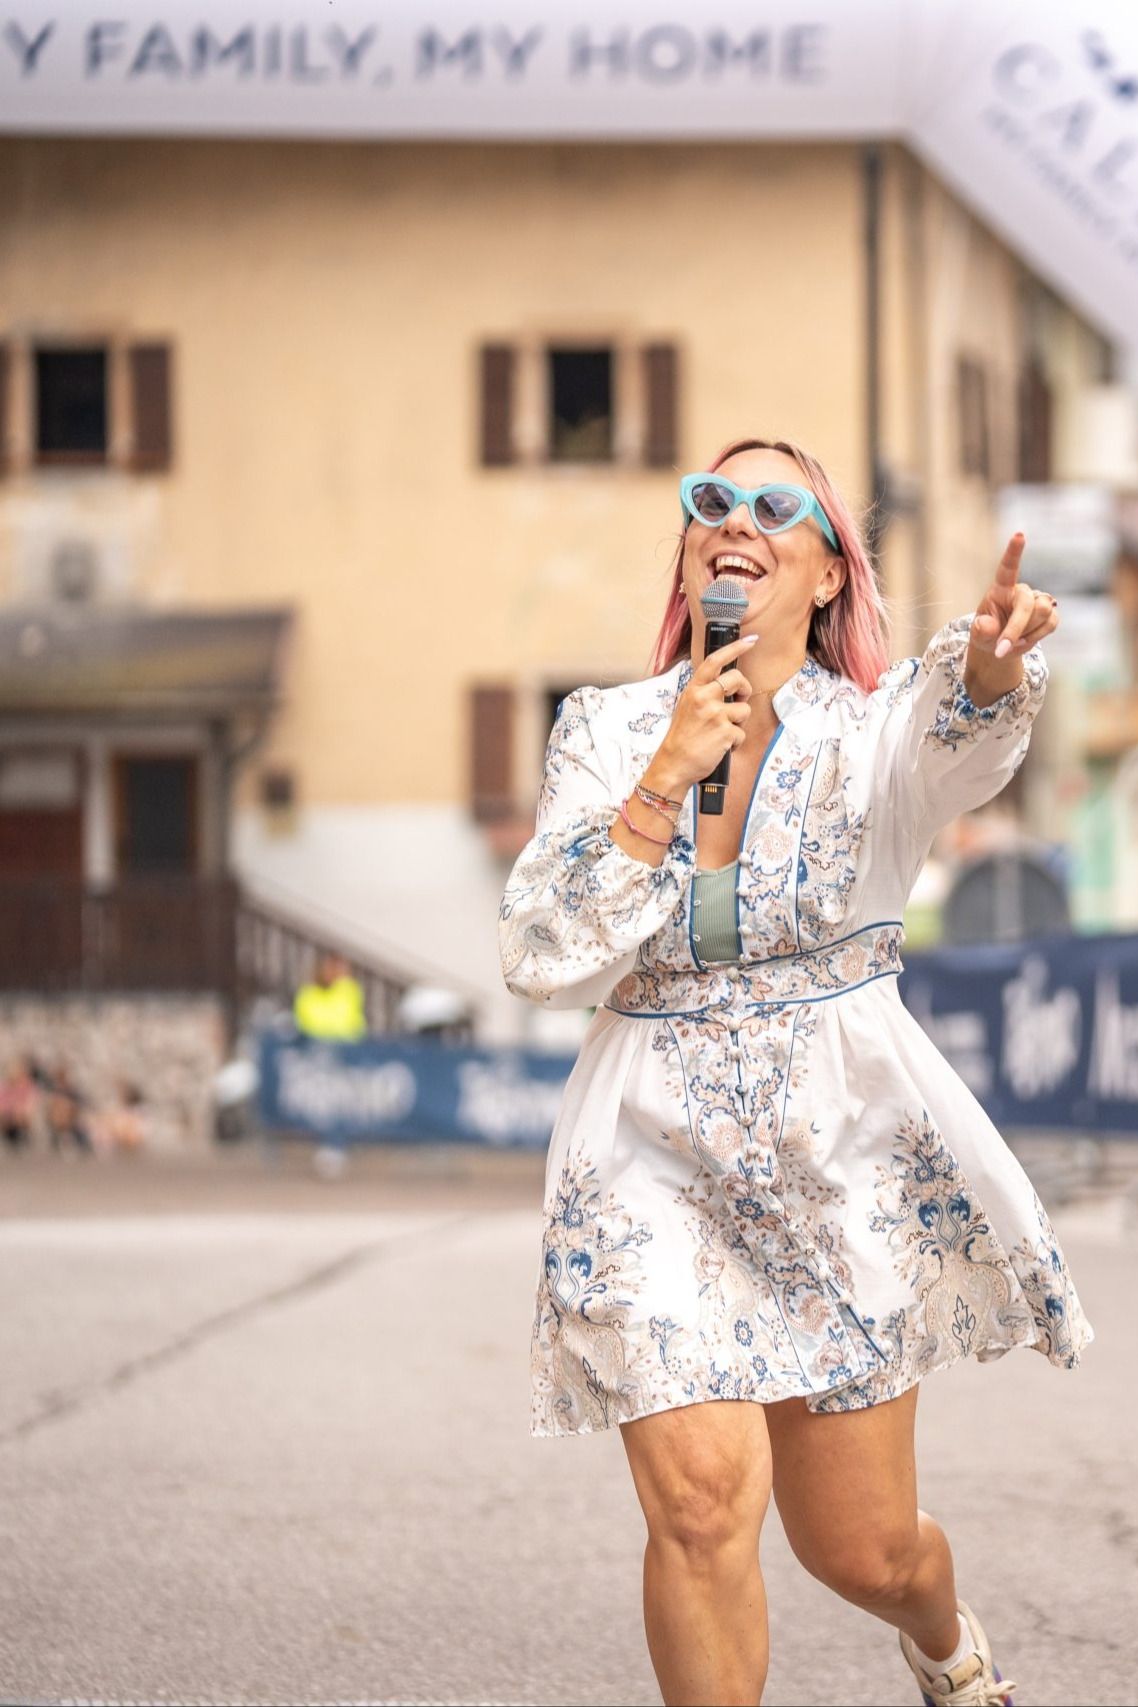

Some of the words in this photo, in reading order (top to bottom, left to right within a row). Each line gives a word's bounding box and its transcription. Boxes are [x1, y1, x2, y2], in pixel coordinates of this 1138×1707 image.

[4, 18, 57, 82] Y
[83, 18, 398, 90] FAMILY,
[413, 22, 545, 84] MY
[566, 20, 834, 87] HOME
